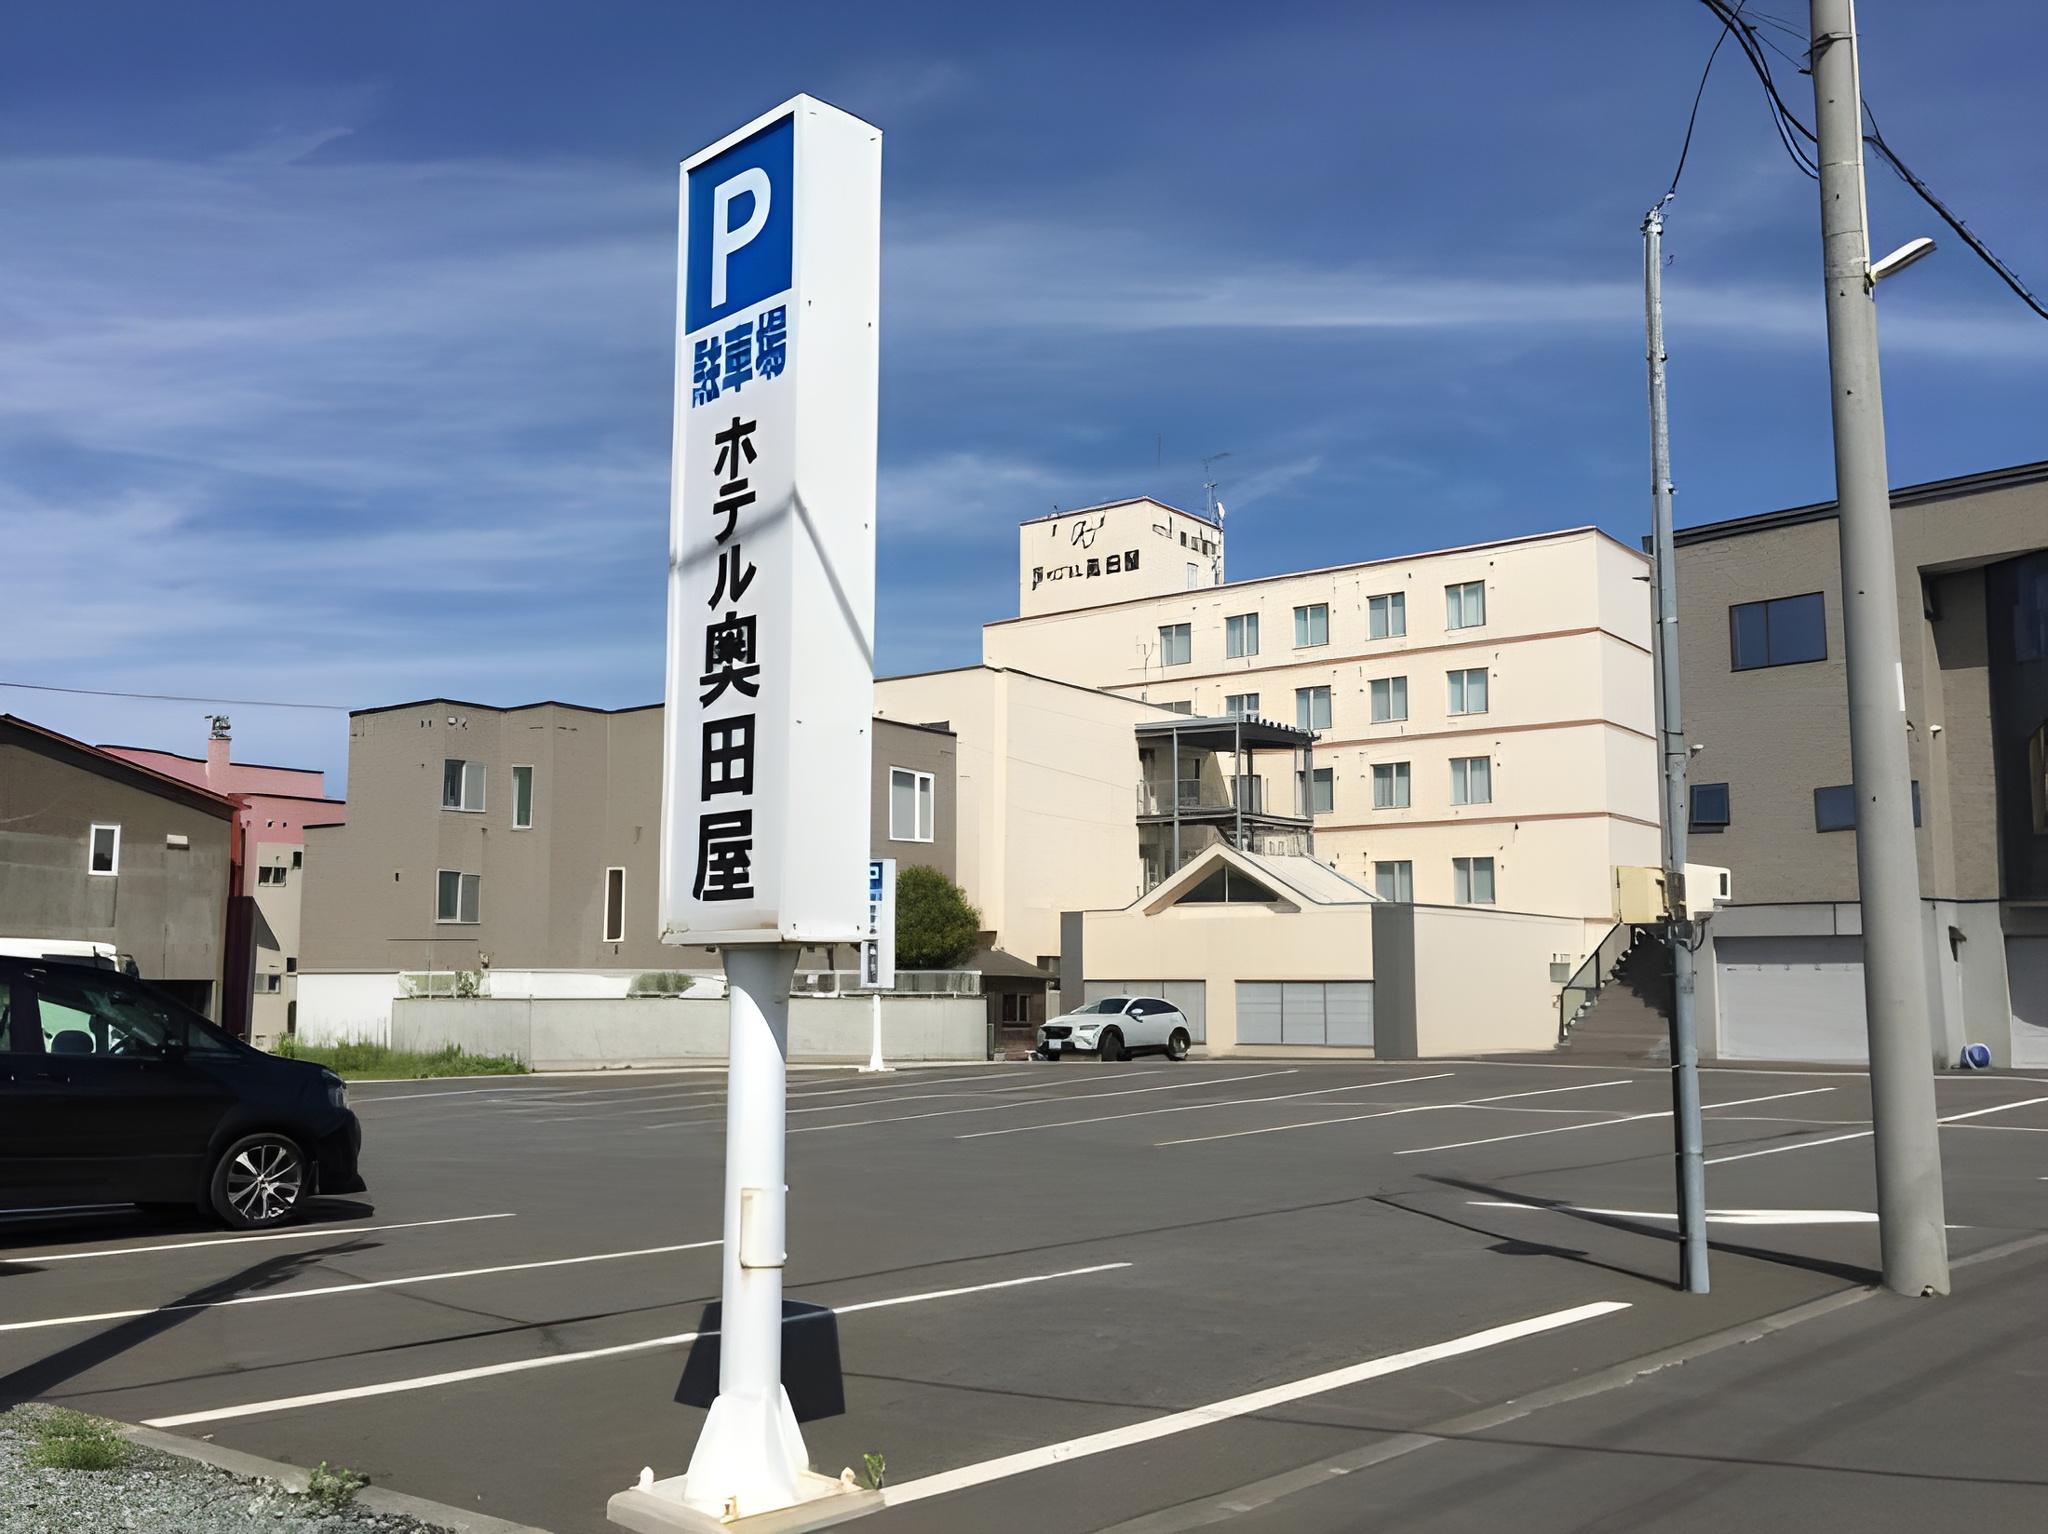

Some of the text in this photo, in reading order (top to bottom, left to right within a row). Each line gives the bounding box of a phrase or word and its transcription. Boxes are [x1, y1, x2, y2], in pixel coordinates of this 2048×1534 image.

[711, 167, 772, 309] P
[692, 416, 761, 902] ホテル奥田屋
